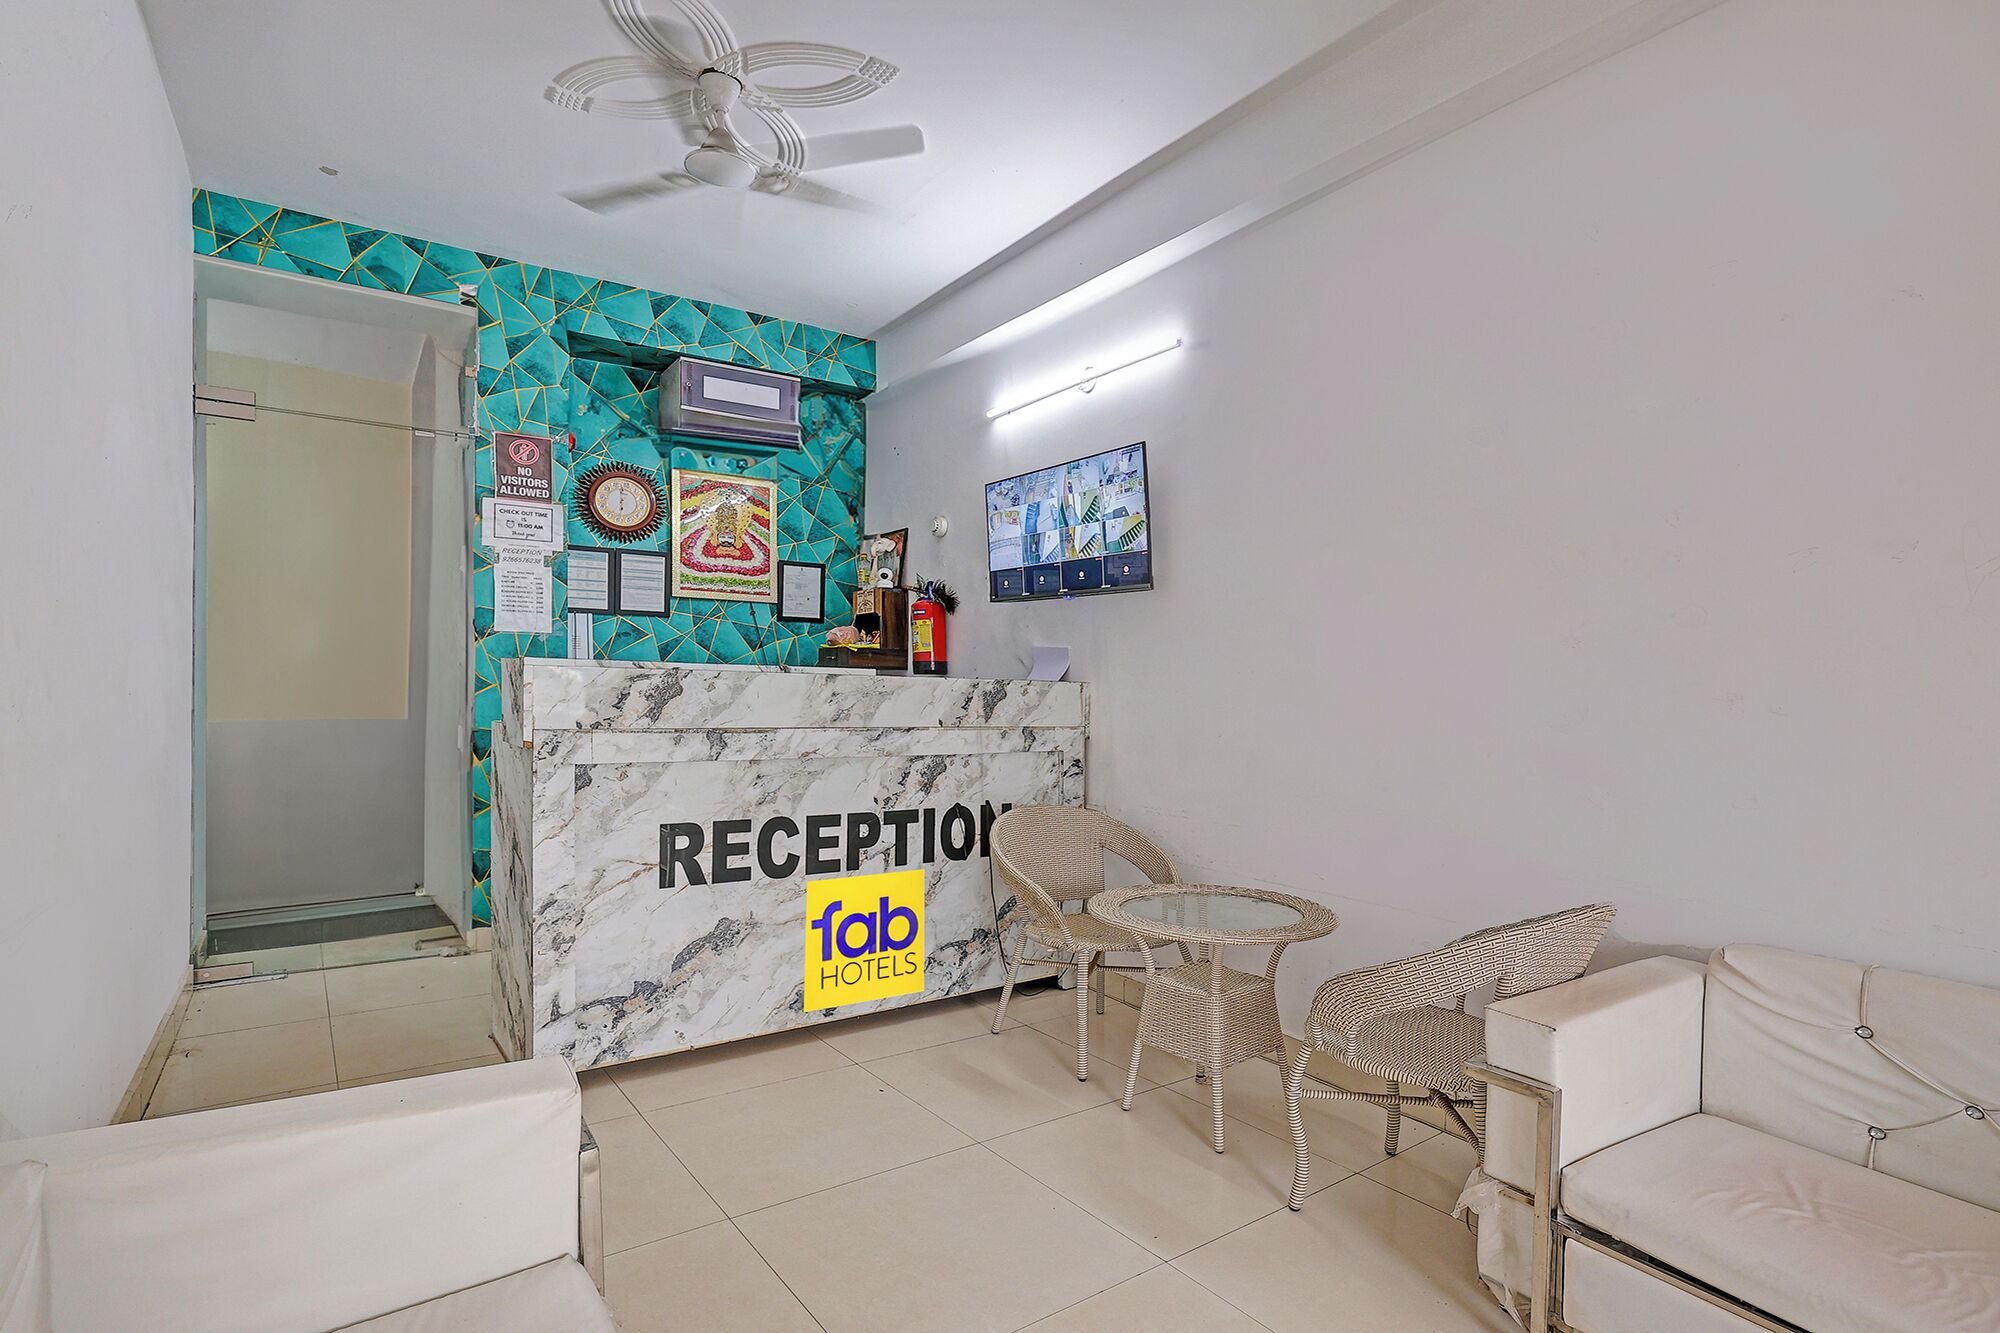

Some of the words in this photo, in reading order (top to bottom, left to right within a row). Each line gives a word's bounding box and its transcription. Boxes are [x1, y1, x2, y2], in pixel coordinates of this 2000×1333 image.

[517, 466, 532, 476] NO
[500, 475, 549, 488] VISITORS
[500, 485, 549, 498] ALLOWED
[499, 508, 520, 516] CHECK
[501, 547, 543, 556] RECEPTION
[658, 800, 1012, 889] RECEPTION
[811, 897, 919, 962] fab
[820, 951, 917, 990] HOTELS
